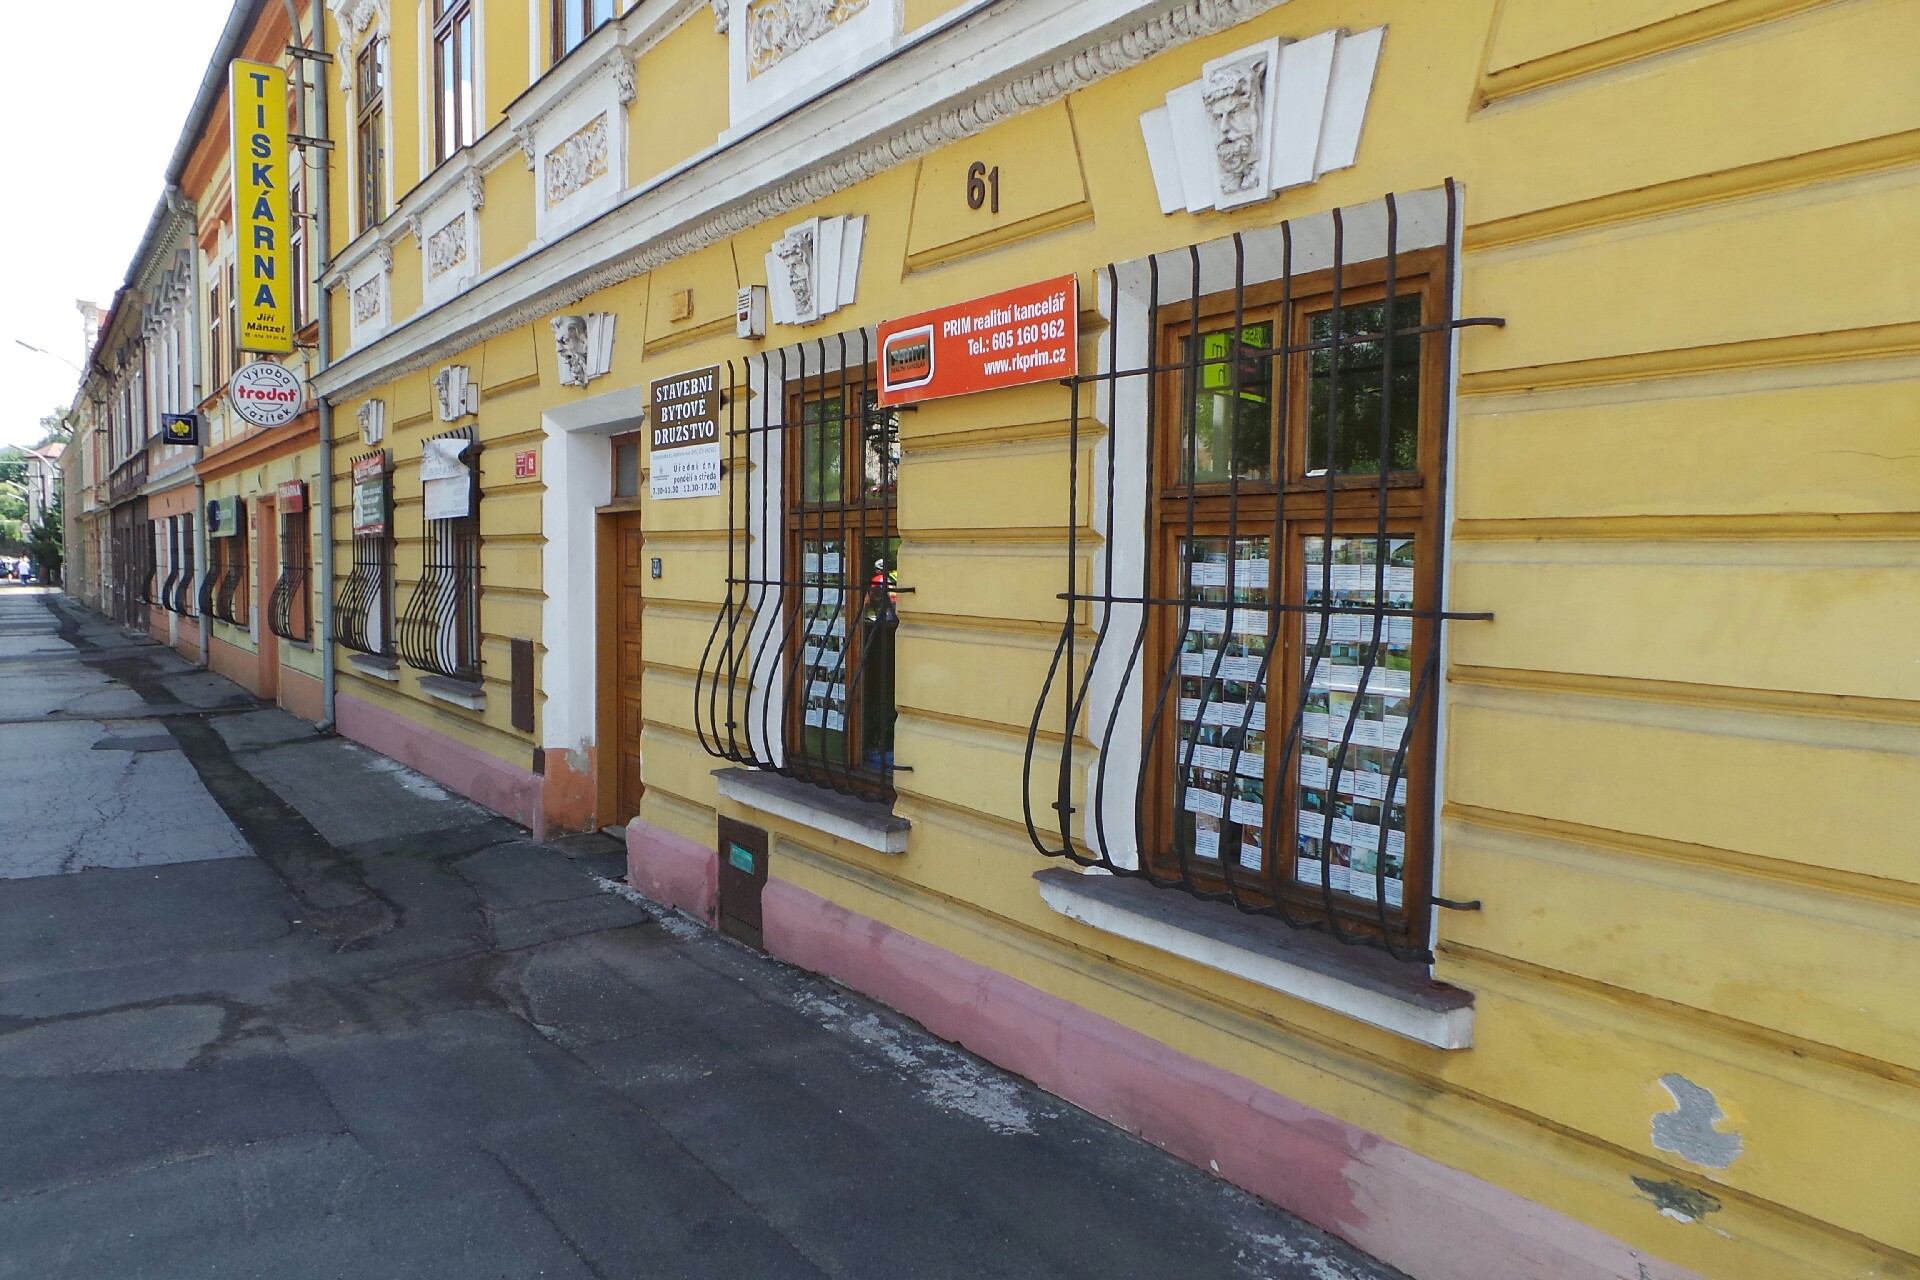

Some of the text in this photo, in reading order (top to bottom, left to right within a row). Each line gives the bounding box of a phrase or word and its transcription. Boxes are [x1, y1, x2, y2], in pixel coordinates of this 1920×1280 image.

[249, 72, 276, 309] TISKÁRNA
[967, 161, 999, 213] 61
[256, 313, 275, 322] Jiří
[943, 291, 1066, 338] PRIM realitní kancelář
[967, 318, 1065, 356] Tel.: 605 160 962
[891, 344, 926, 366] PRIM
[983, 348, 1066, 376] www.rkprim.cz
[242, 367, 291, 385] Výroba
[656, 369, 713, 403] STAVEBNÍ
[238, 385, 296, 402] trodat
[243, 405, 292, 422] razítek
[661, 394, 706, 423] BYTOVÉ
[654, 420, 714, 446] DRUŽSTVO
